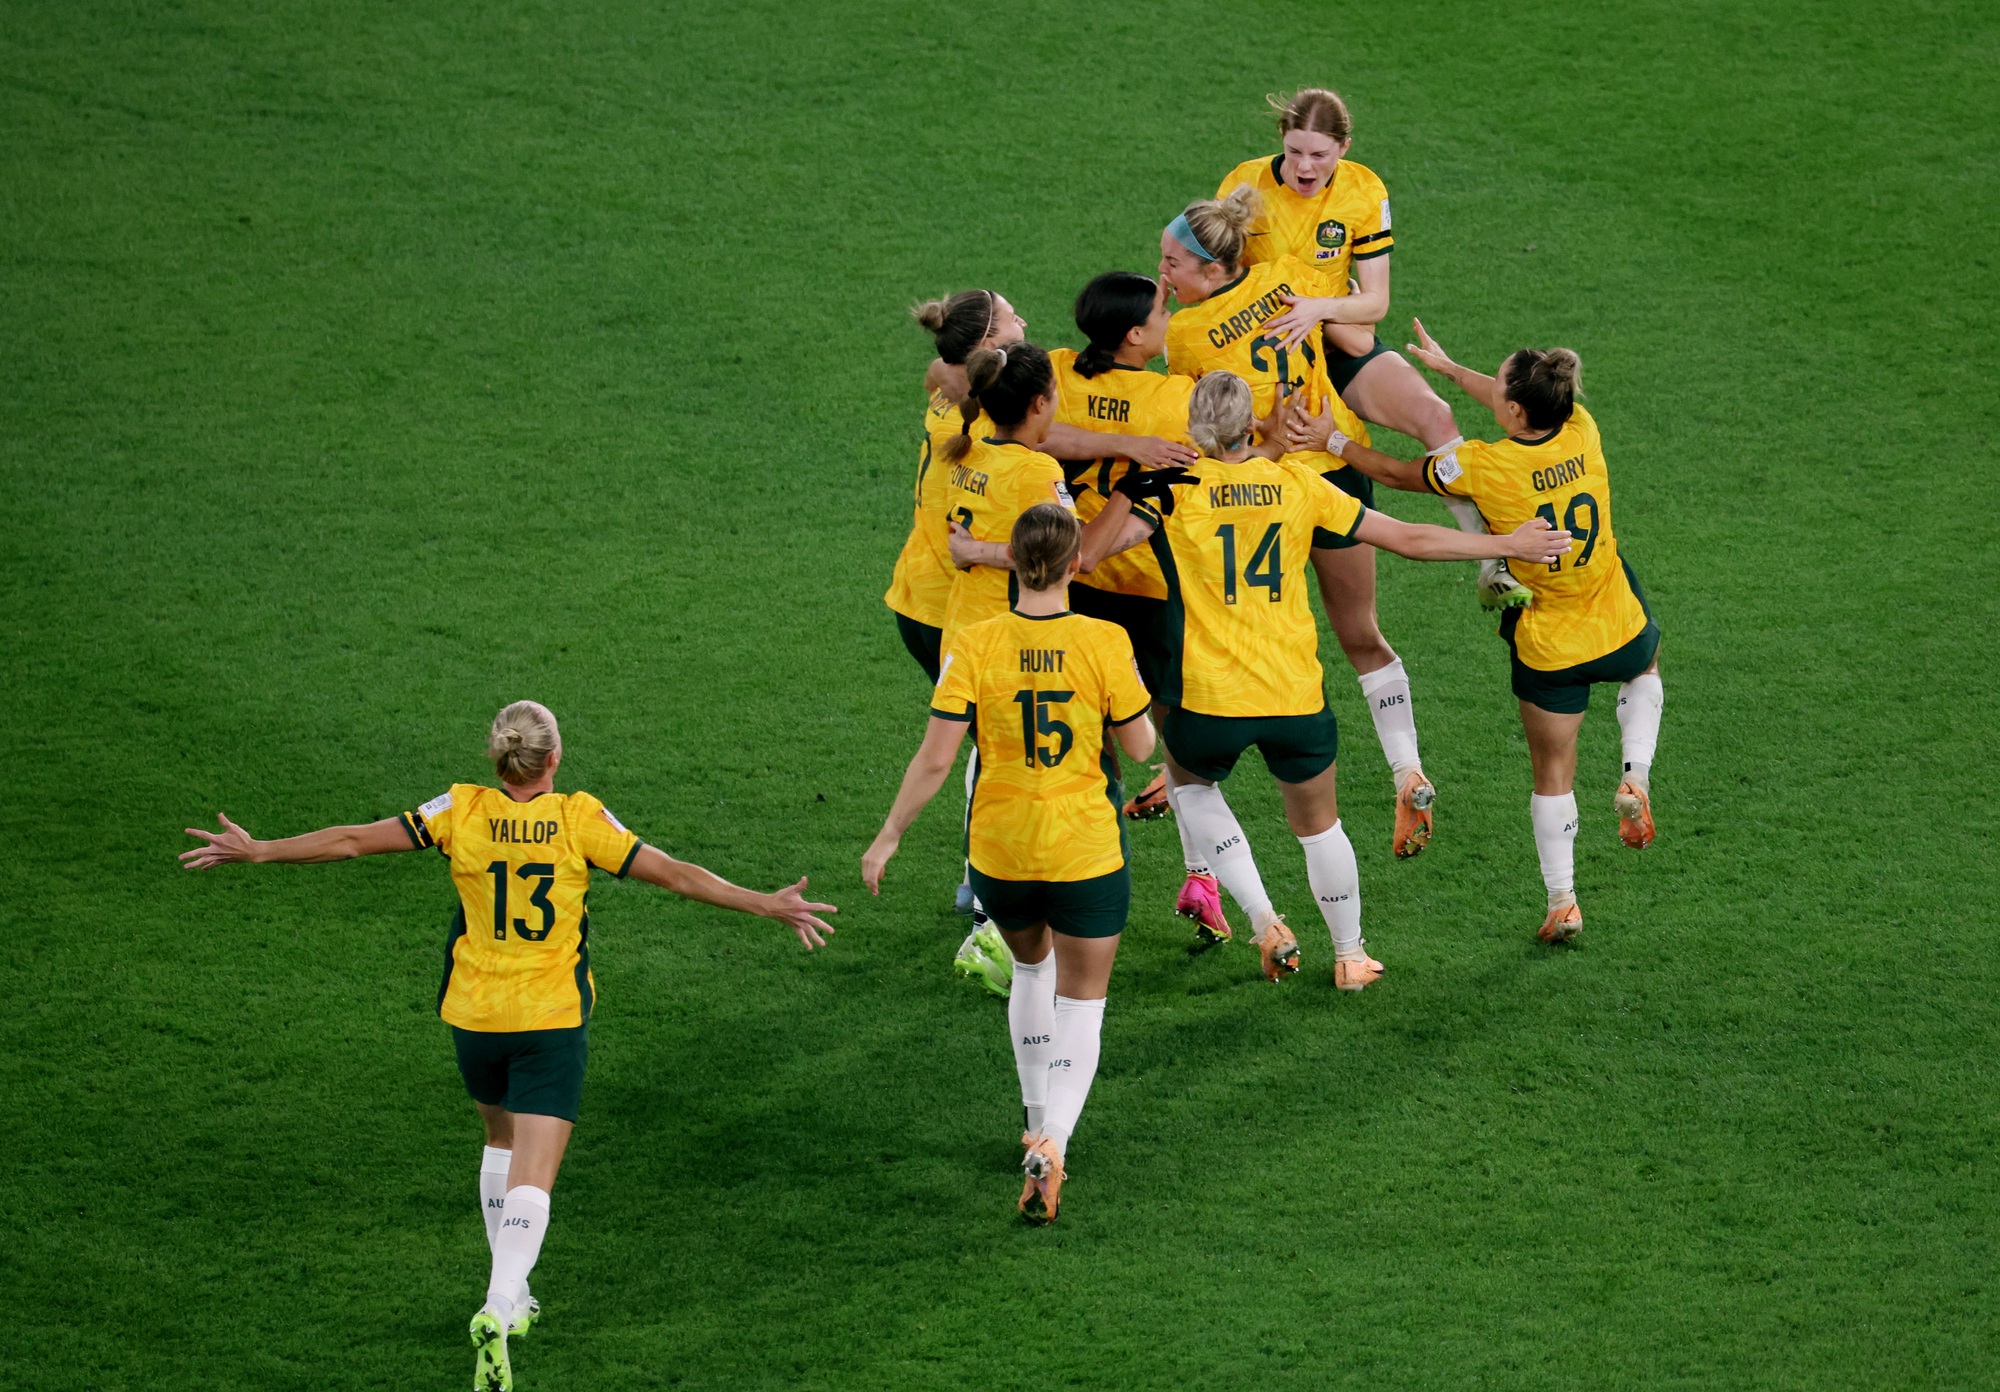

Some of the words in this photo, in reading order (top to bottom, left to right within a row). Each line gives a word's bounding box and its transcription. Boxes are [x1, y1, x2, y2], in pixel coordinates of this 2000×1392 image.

[1208, 283, 1296, 349] CARPENTER
[1250, 334, 1316, 399] 2
[1088, 395, 1130, 422] KERR
[951, 463, 988, 497] OWLER
[1532, 454, 1586, 492] GORRY
[1210, 484, 1282, 508] KENNEDY
[1535, 492, 1599, 573] 19
[1215, 522, 1284, 605] 14
[1020, 649, 1065, 672] HUNT
[1380, 695, 1404, 709] AUS
[1013, 690, 1075, 768] 15
[489, 819, 558, 844] YALLOP
[1216, 836, 1240, 854] AUS
[486, 861, 556, 941] 13
[1321, 894, 1348, 902] AUS
[1023, 1035, 1050, 1045] AUS
[488, 1198, 504, 1208] AU
[503, 1218, 530, 1228] AUS
